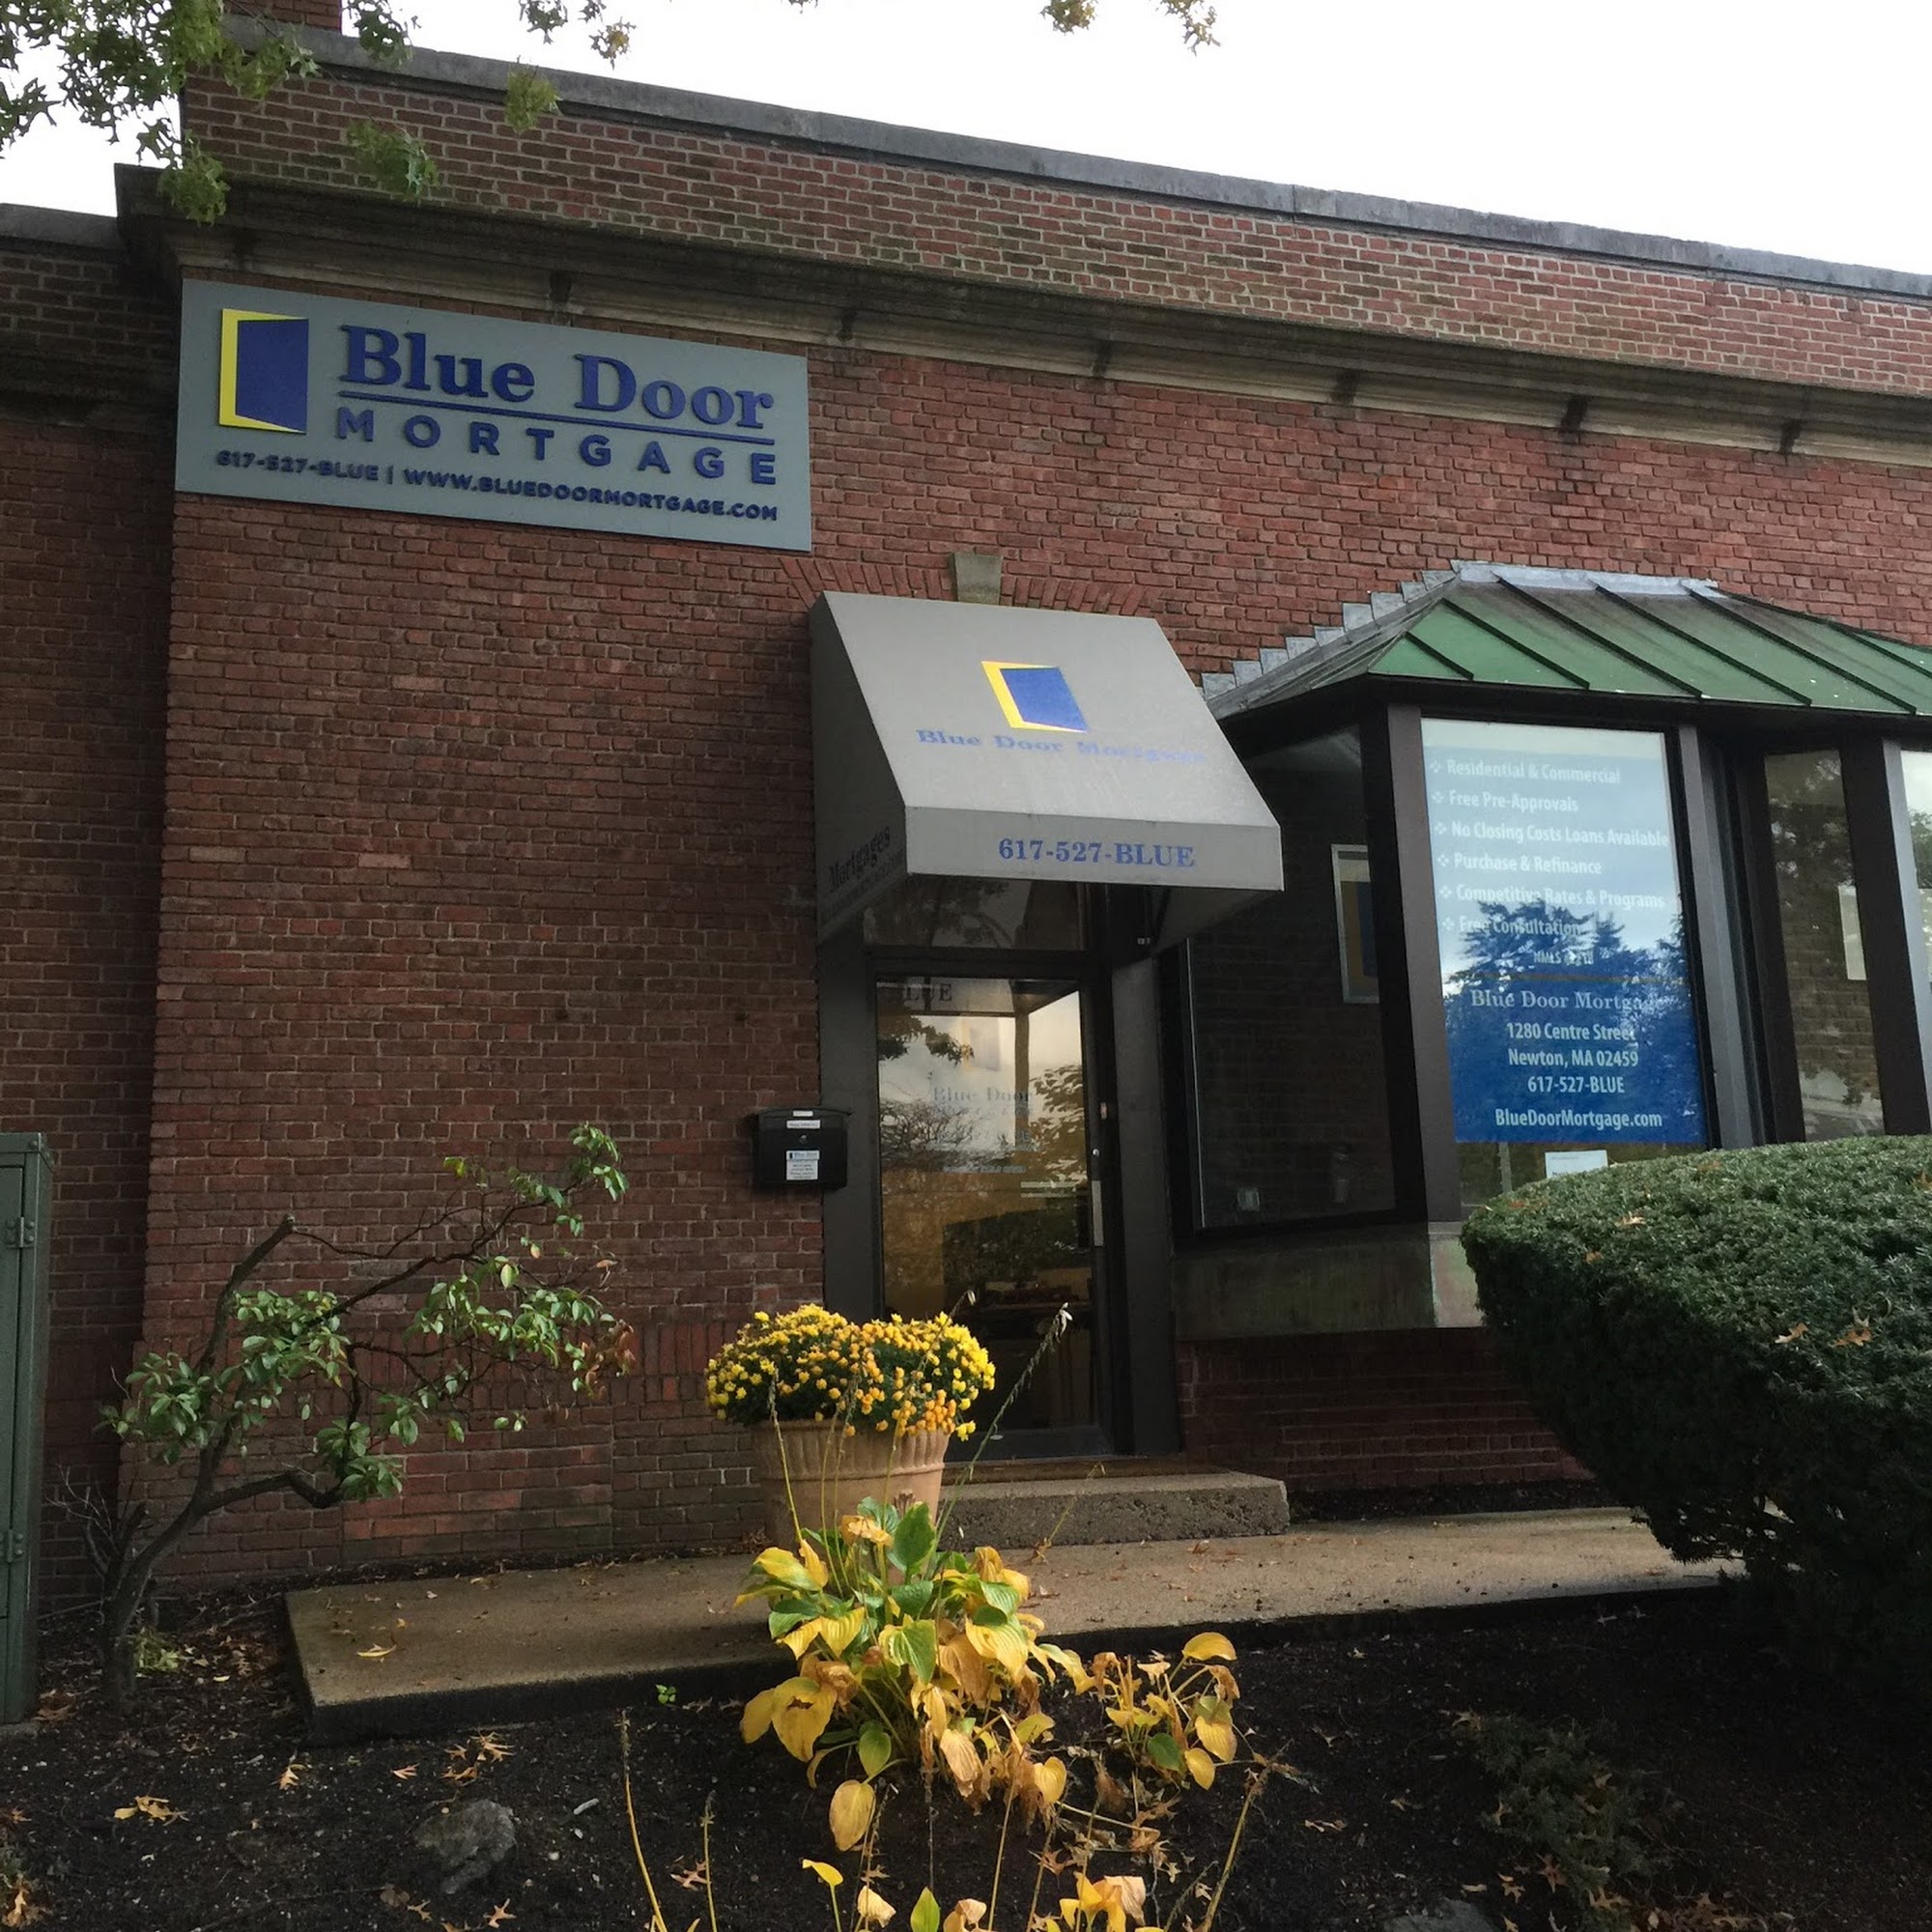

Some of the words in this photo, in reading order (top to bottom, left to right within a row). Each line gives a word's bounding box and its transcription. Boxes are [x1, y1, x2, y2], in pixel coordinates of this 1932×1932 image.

[337, 324, 535, 403] Blue
[574, 353, 774, 429] Door
[335, 406, 776, 485] MORTGAGE
[215, 449, 379, 482] 617-527-BLUE
[403, 468, 778, 522] WWW.BLUEDOORMORTGAGE.COM
[915, 728, 983, 749] Blue
[993, 733, 1063, 753] Door
[1446, 759, 1525, 779] Residential
[1528, 764, 1539, 779] &
[1542, 764, 1621, 784] Commercial
[1449, 790, 1479, 806] Free
[1483, 791, 1578, 813] Pre-Approvals
[1451, 821, 1470, 837] No
[1473, 822, 1524, 843] Closing
[1527, 825, 1561, 841] Costs
[1565, 827, 1605, 843] Loans
[1607, 829, 1668, 847] Available
[998, 838, 1196, 868] 617-527-BLUE
[1454, 852, 1518, 870] Purchase
[1520, 855, 1530, 870] &
[1534, 856, 1602, 874] Refinance
[1457, 885, 1542, 906] Competitive
[1545, 889, 1582, 905] Rates
[1586, 891, 1596, 905] &
[1599, 890, 1664, 910] Programs
[1459, 917, 1490, 932] Free
[1493, 919, 1581, 935] Consultation
[1470, 989, 1516, 1008] Blue
[1521, 991, 1569, 1009] Door
[1506, 1022, 1541, 1038] 1280
[1545, 1023, 1590, 1040] Centre
[1594, 1025, 1635, 1041] Street
[1508, 1048, 1568, 1068] Newton,
[1572, 1051, 1594, 1066] MA
[1597, 1051, 1638, 1067] 02459
[1527, 1075, 1625, 1094] 617-527-BLUE
[1495, 1108, 1662, 1131] BlueDoorMortgage.com
